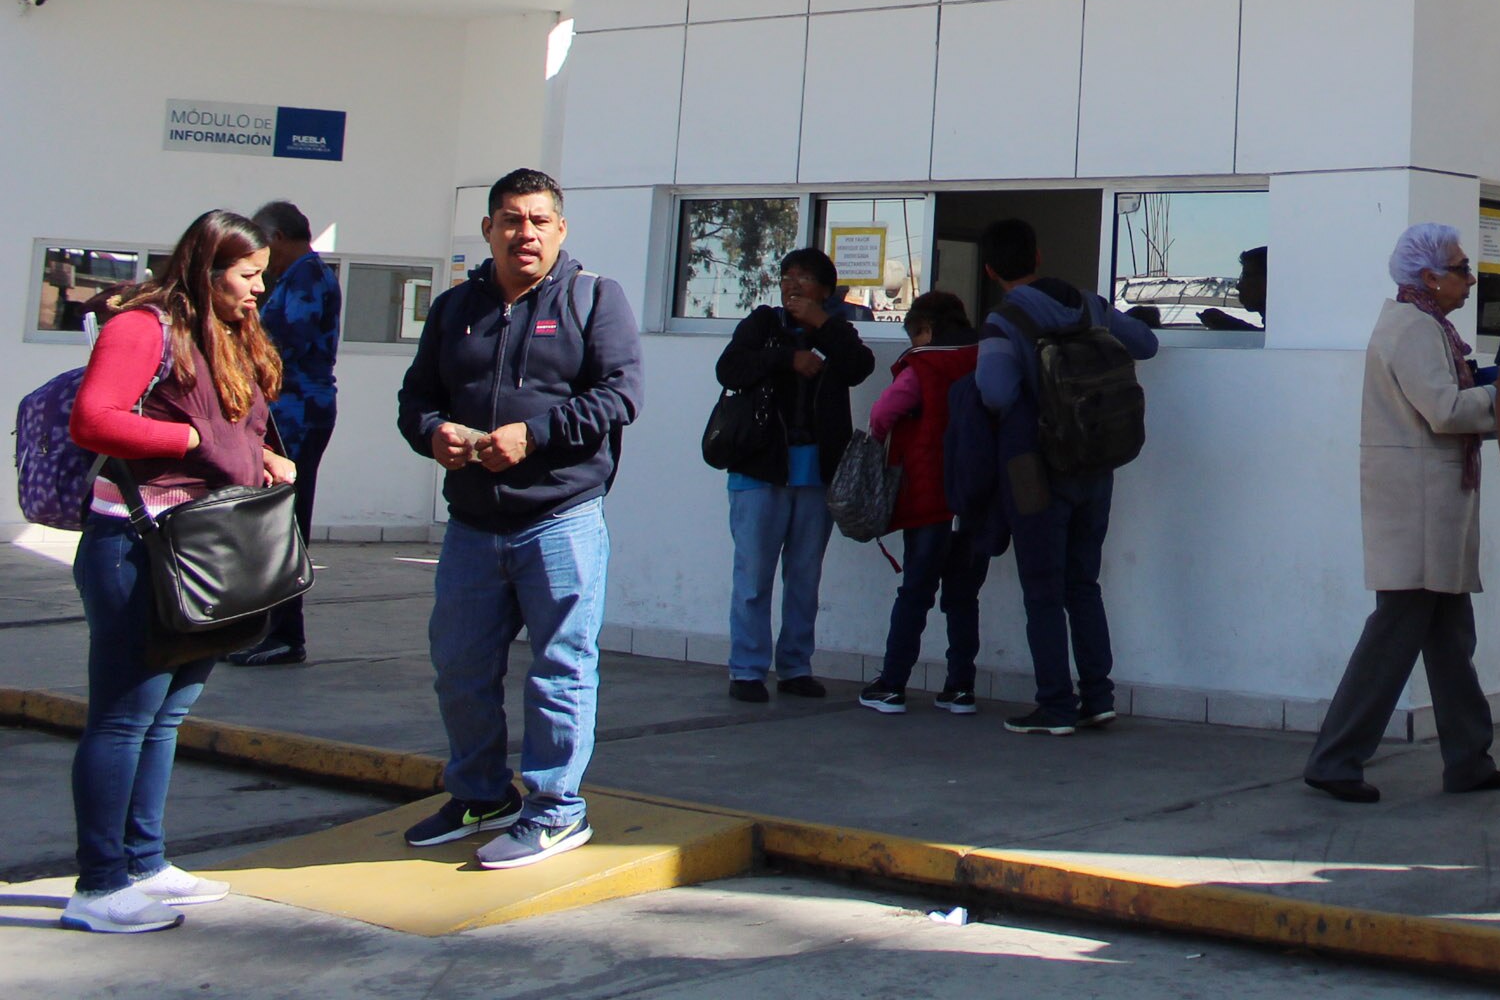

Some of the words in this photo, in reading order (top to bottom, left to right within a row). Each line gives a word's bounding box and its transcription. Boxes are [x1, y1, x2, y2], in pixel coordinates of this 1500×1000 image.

[170, 108, 250, 129] MÓDULO
[253, 117, 273, 130] DE
[169, 129, 272, 146] INFORMACIÓN
[292, 134, 327, 145] PUEBLA
